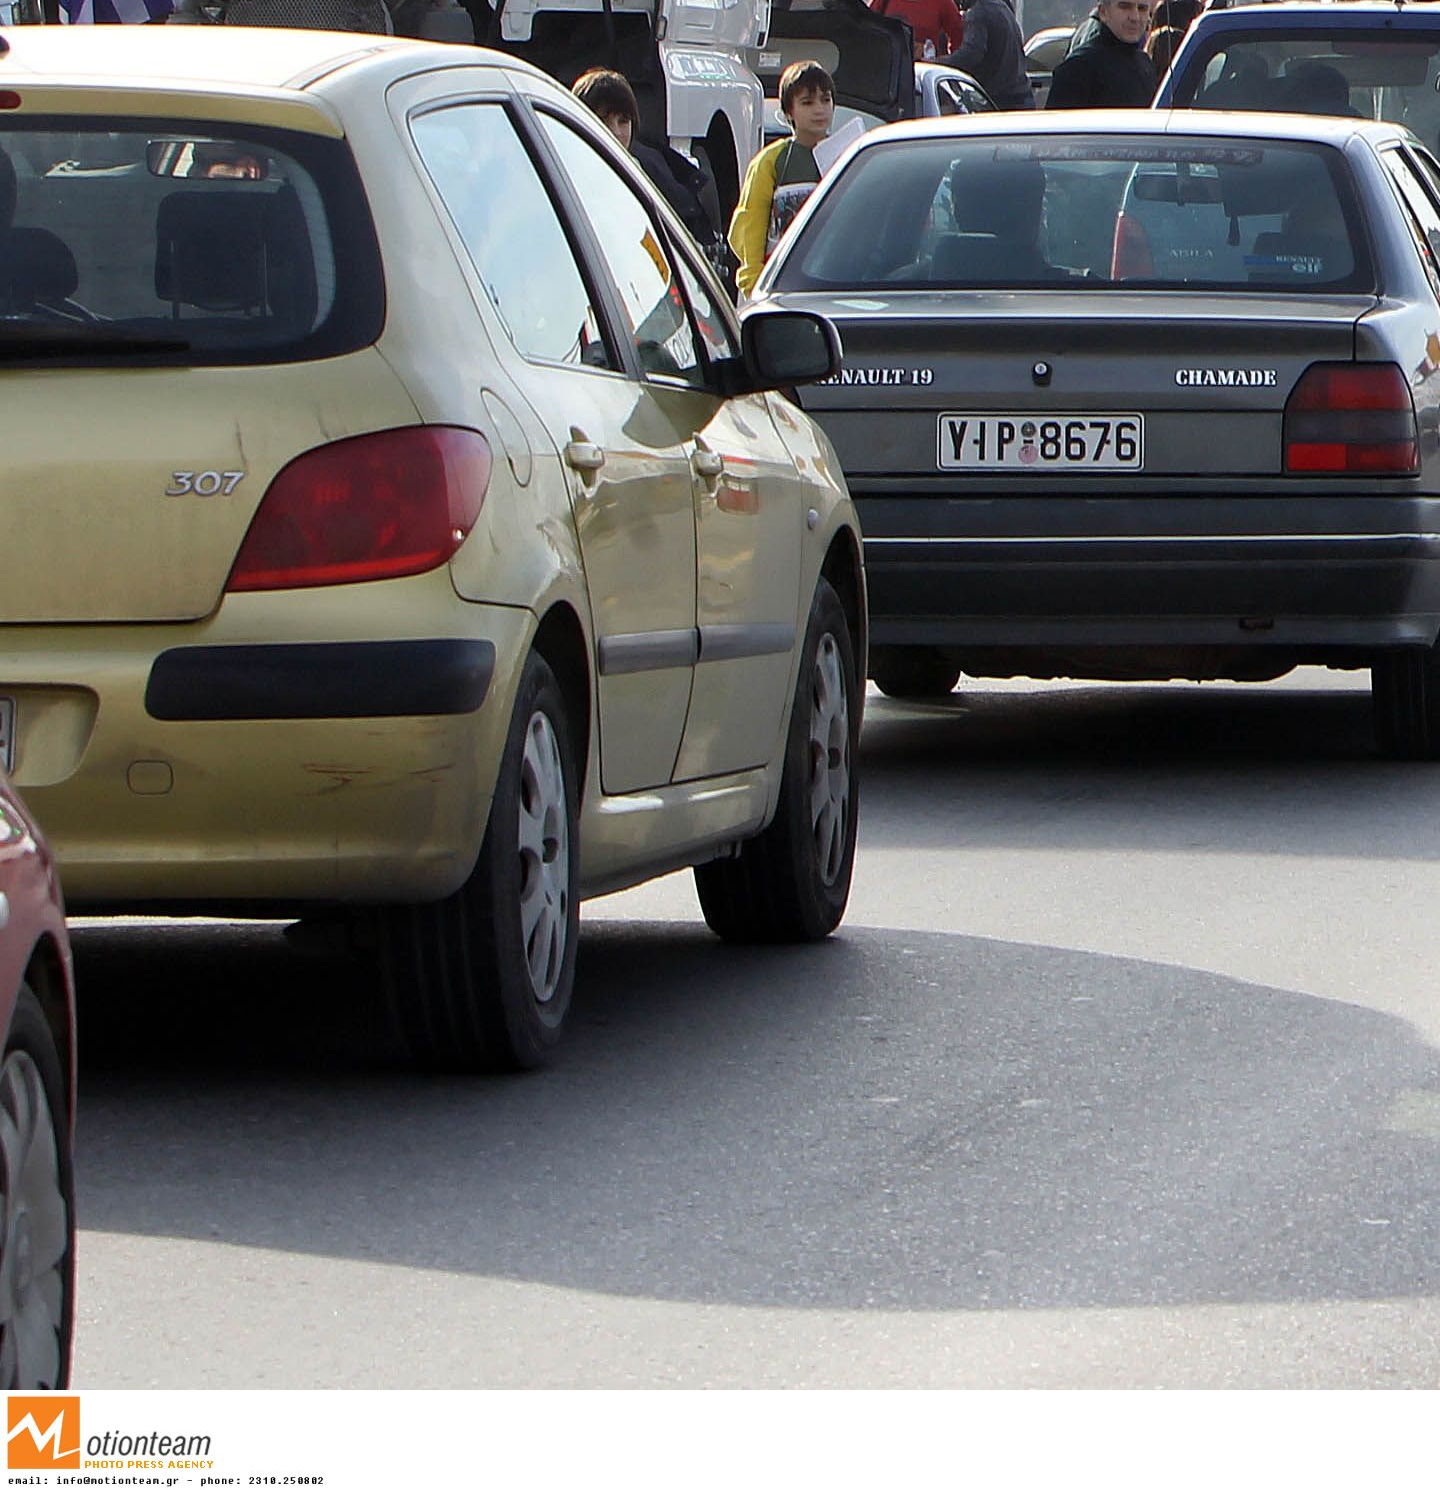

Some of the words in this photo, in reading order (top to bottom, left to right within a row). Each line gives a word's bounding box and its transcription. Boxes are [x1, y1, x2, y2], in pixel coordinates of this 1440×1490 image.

[910, 368, 935, 386] 19
[1174, 368, 1278, 387] CHAMADE
[165, 470, 245, 496] 307
